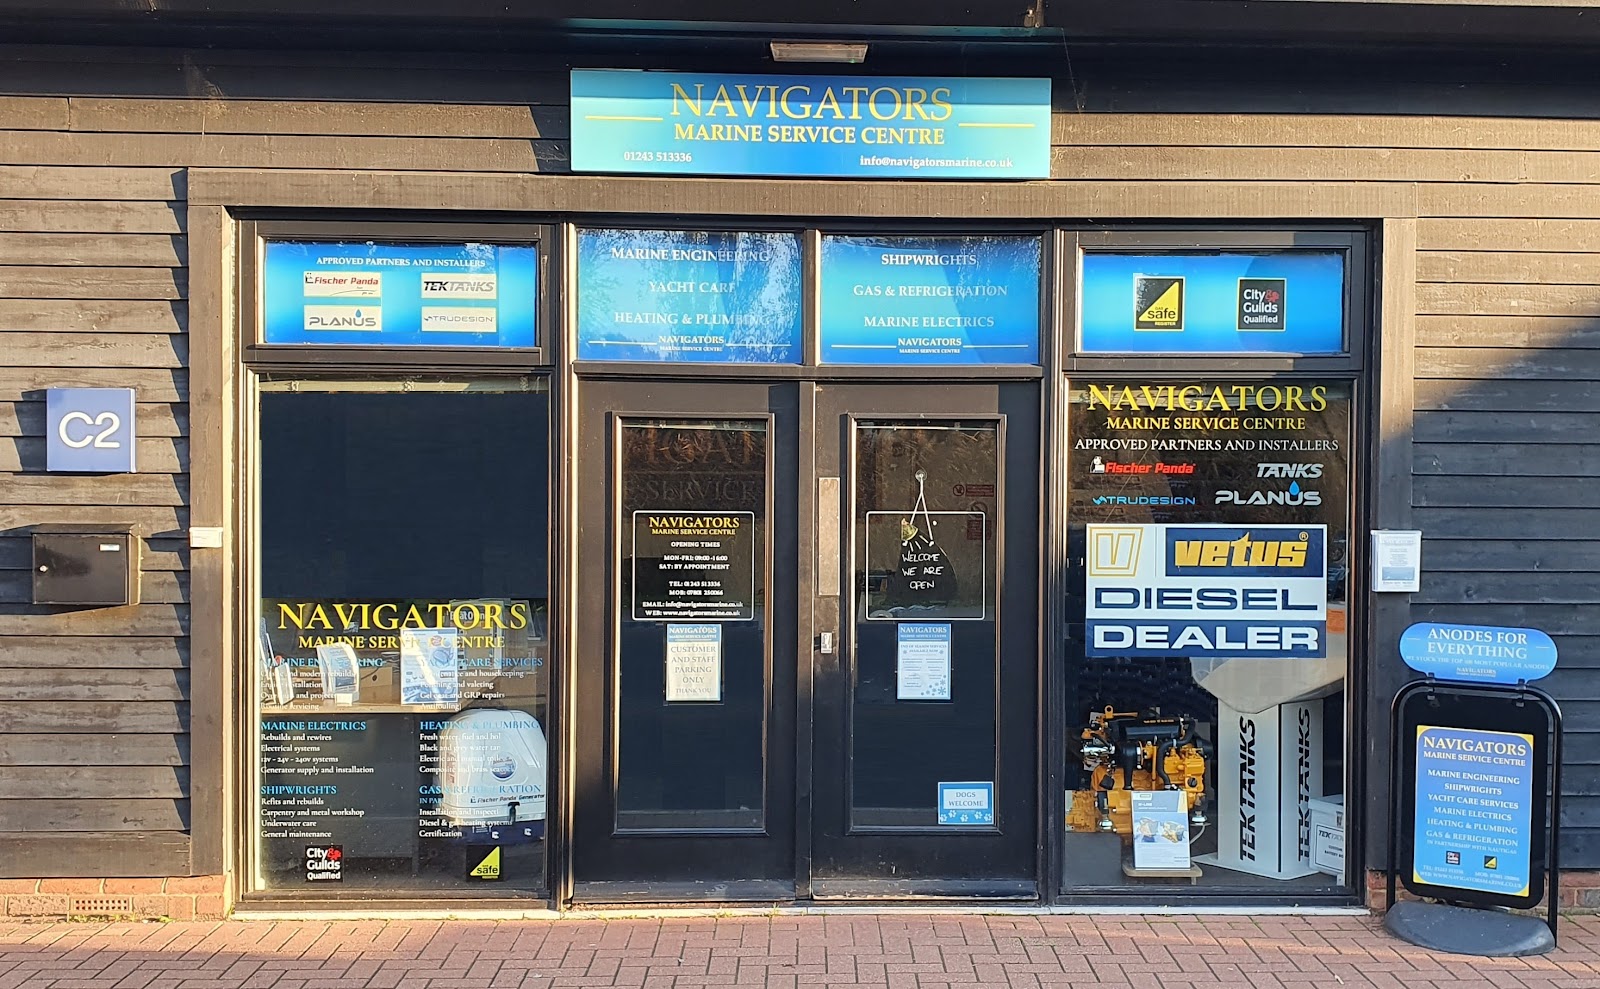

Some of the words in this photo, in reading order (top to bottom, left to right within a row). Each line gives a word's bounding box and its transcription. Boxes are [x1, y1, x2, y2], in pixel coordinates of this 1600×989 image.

[670, 83, 953, 121] NAVIGATORS
[674, 123, 763, 142] MARINE
[768, 125, 856, 144] SERVICE
[860, 127, 946, 145] CENTRE
[623, 151, 654, 162] 01243
[656, 151, 692, 163] 513336
[859, 155, 1013, 169] info@navigatorsmarine.co.uk
[611, 247, 668, 260] MARINE
[673, 249, 769, 262] ENGINEERING
[881, 254, 977, 266] SHIPWRIGHTS
[316, 257, 364, 265] APPROVED
[365, 257, 410, 266] PARTNERS
[412, 258, 432, 266] AND
[434, 259, 485, 267] INSTALLERS
[350, 277, 379, 285] Panda
[424, 281, 495, 292] TEKTANKS
[649, 281, 695, 293] YACHT
[853, 285, 881, 296] GAS
[885, 285, 895, 296] &
[899, 285, 1008, 297] REFRIGERATION
[1243, 289, 1266, 303] City
[1243, 302, 1278, 313] Guilds
[614, 312, 678, 325] HEATING
[682, 313, 692, 325] &
[1147, 308, 1176, 320] safe
[1243, 315, 1278, 324] Qualified
[309, 317, 377, 327] PLANUS
[864, 316, 919, 327] MARINE
[922, 316, 994, 328] ELECTRICS
[659, 335, 724, 344] NAVIGATORS
[898, 337, 962, 346] NAVIGATORS
[1087, 384, 1327, 412] NAVIGATORS
[1106, 417, 1170, 430] MARINE
[1174, 417, 1239, 430] SERVICE
[1243, 417, 1306, 430] CENTRE
[58, 411, 121, 449] C2
[1074, 438, 1148, 450] APPROVED
[1151, 438, 1222, 450] PARTNERS
[1225, 439, 1256, 451] AND
[1259, 439, 1339, 451] INSTALLERS
[1105, 462, 1152, 473] Fischer
[1155, 462, 1194, 474] Panda
[1257, 463, 1324, 478] TANKS
[1106, 496, 1196, 505] TRUDESIGN
[1214, 490, 1322, 506] PLANUS
[649, 516, 740, 528] NAVIGATORS
[1175, 532, 1308, 567] vetus
[902, 553, 940, 563] WELCOME
[902, 567, 918, 577] WE
[923, 566, 944, 576] ARE
[909, 580, 935, 589] OPEN
[1094, 587, 1318, 611] DIESEL
[277, 603, 528, 630] NAVIGATORS
[299, 636, 365, 649] MARINE
[441, 636, 505, 649] CENTRE
[1093, 625, 1319, 650] DEALER
[1428, 628, 1493, 643] ANODES
[1497, 632, 1528, 645] FOR
[1428, 642, 1528, 660] EVERYTHING
[494, 657, 543, 667] SERVICES
[479, 669, 525, 678] housekeeping
[1457, 666, 1497, 674] NAVIGATORS
[466, 680, 494, 689] valeting
[463, 691, 481, 699] GRP
[482, 691, 506, 700] repairs
[261, 721, 305, 730] MARINE
[308, 721, 366, 730] ELECTRICS
[420, 721, 468, 730] HEATING
[261, 733, 291, 741] Rebuilds
[293, 733, 305, 741] and
[420, 732, 438, 740] Fresh
[261, 744, 292, 752] Electrical
[294, 745, 320, 753] systems
[420, 743, 438, 751] Black
[1423, 736, 1526, 757] NAVIGATORS
[312, 756, 339, 764] systems
[1423, 751, 1456, 760] MARINE
[1458, 754, 1492, 764] SERVICE
[1493, 757, 1526, 767] CENTRE
[297, 767, 319, 775] supply
[1427, 769, 1461, 779] MARINE
[1462, 772, 1520, 785] ENGINEERING
[261, 785, 337, 795] SHIPWRIGHTS
[419, 785, 442, 794] GAS
[1239, 715, 1256, 861] TEKTANKS
[1298, 706, 1310, 862] TEKTANKS
[1444, 783, 1502, 796] SHIPWRIGHTS
[1427, 793, 1455, 803] YACHT
[1457, 796, 1478, 806] CARE
[1480, 798, 1519, 810] SERVICES
[261, 809, 296, 817] Carpentry
[332, 809, 364, 817] workshop
[1433, 806, 1467, 816] MARINE
[1468, 809, 1512, 821] ELECTRICS
[419, 818, 440, 826] Diesel
[1427, 818, 1464, 829] HEATING
[1473, 823, 1518, 834] PLUMBING
[419, 829, 463, 837] Certification
[1426, 830, 1443, 839] GAS
[1445, 831, 1451, 839] &
[1452, 832, 1519, 847] REFRIGERATION
[1434, 840, 1471, 849] PARTNERSHIP
[306, 848, 328, 860] City
[306, 860, 341, 870] Guilds
[477, 865, 498, 874] safe
[307, 871, 341, 881] Qualified
